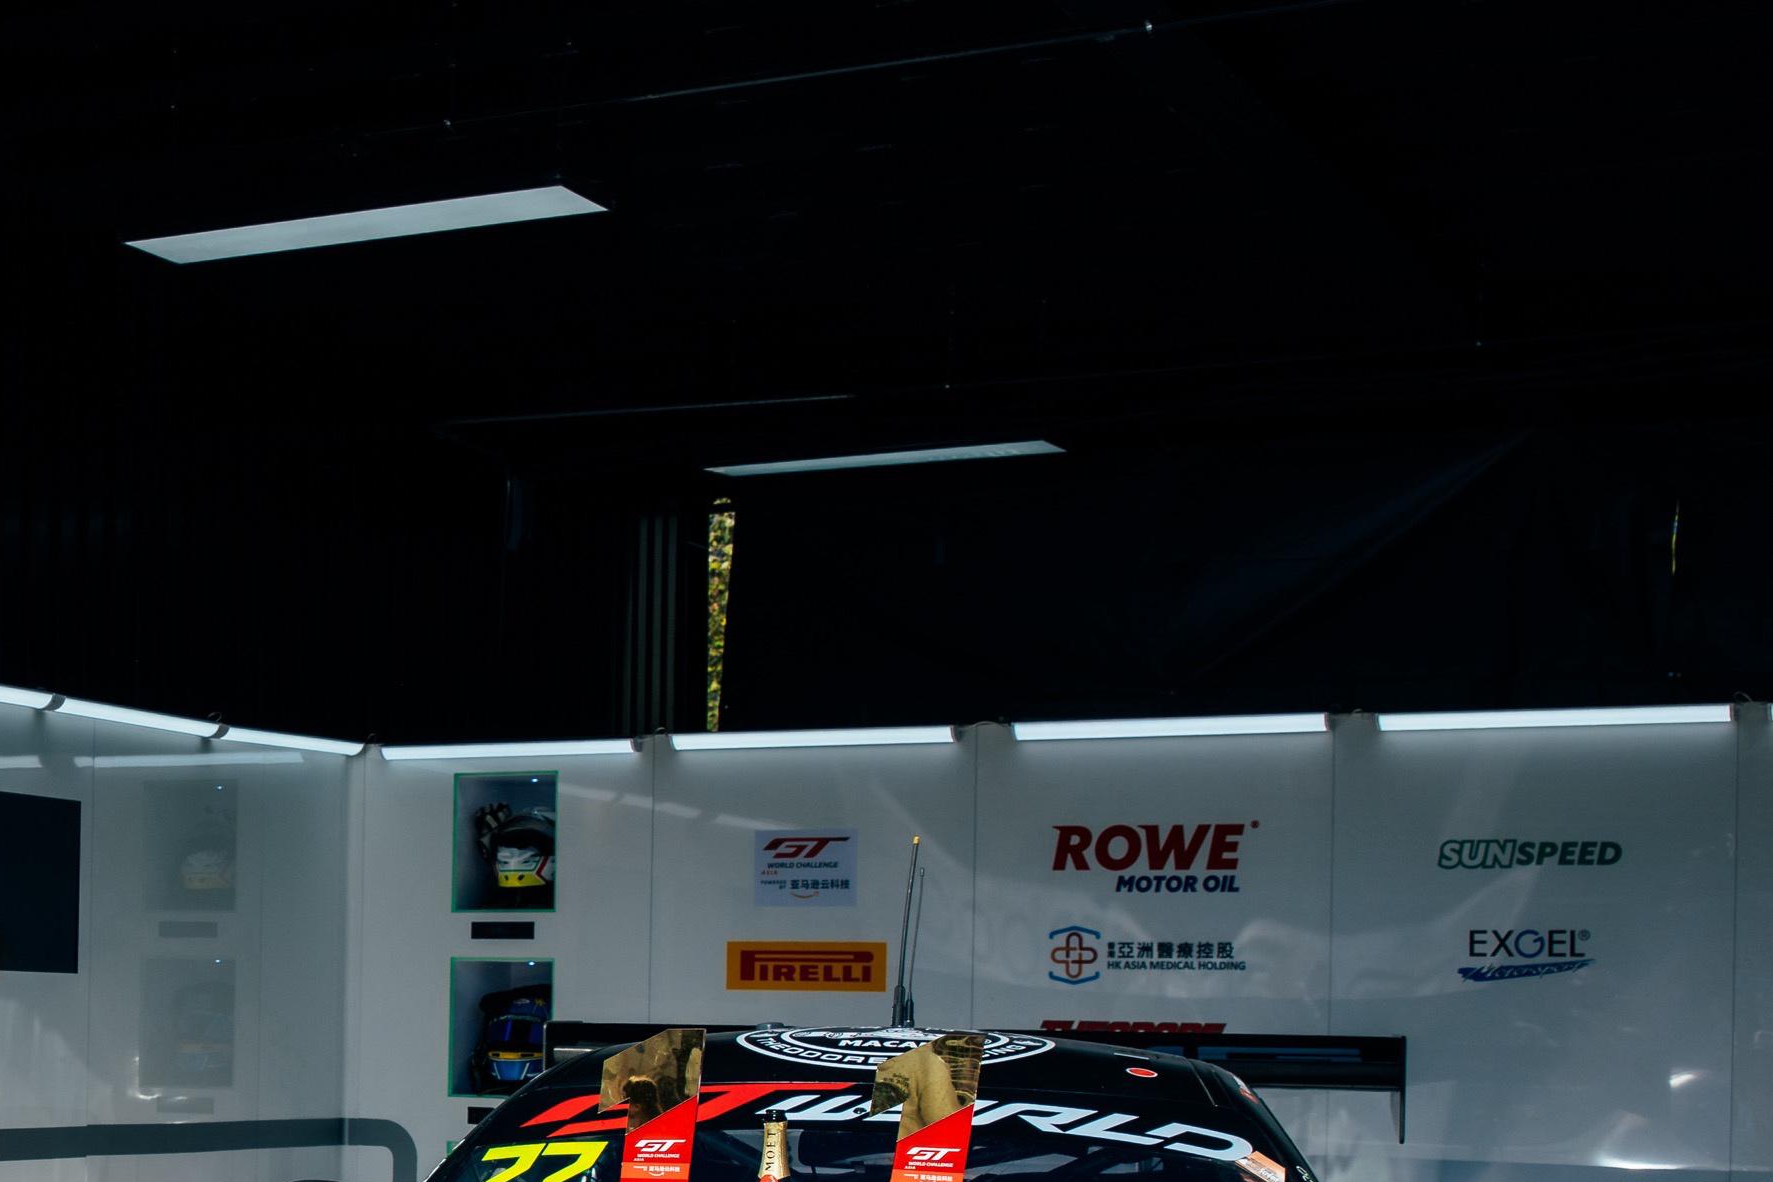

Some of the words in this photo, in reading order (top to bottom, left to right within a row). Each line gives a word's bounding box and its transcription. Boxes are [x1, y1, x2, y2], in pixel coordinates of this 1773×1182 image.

[1052, 823, 1245, 871] ROWE
[1438, 838, 1623, 869] SUNSPEED
[767, 861, 794, 869] WORLD
[795, 861, 839, 869] CHALLENGE
[1115, 875, 1197, 893] MOTOR
[1202, 875, 1241, 893] OIL
[740, 950, 874, 983] PIRELLI
[1107, 960, 1122, 970] HK
[1123, 960, 1146, 970] ASIA
[1149, 960, 1196, 970] MEDICAL
[1198, 961, 1246, 971] HOLDING
[757, 1036, 887, 1066] THEODORE
[754, 1094, 1253, 1162] WRLD
